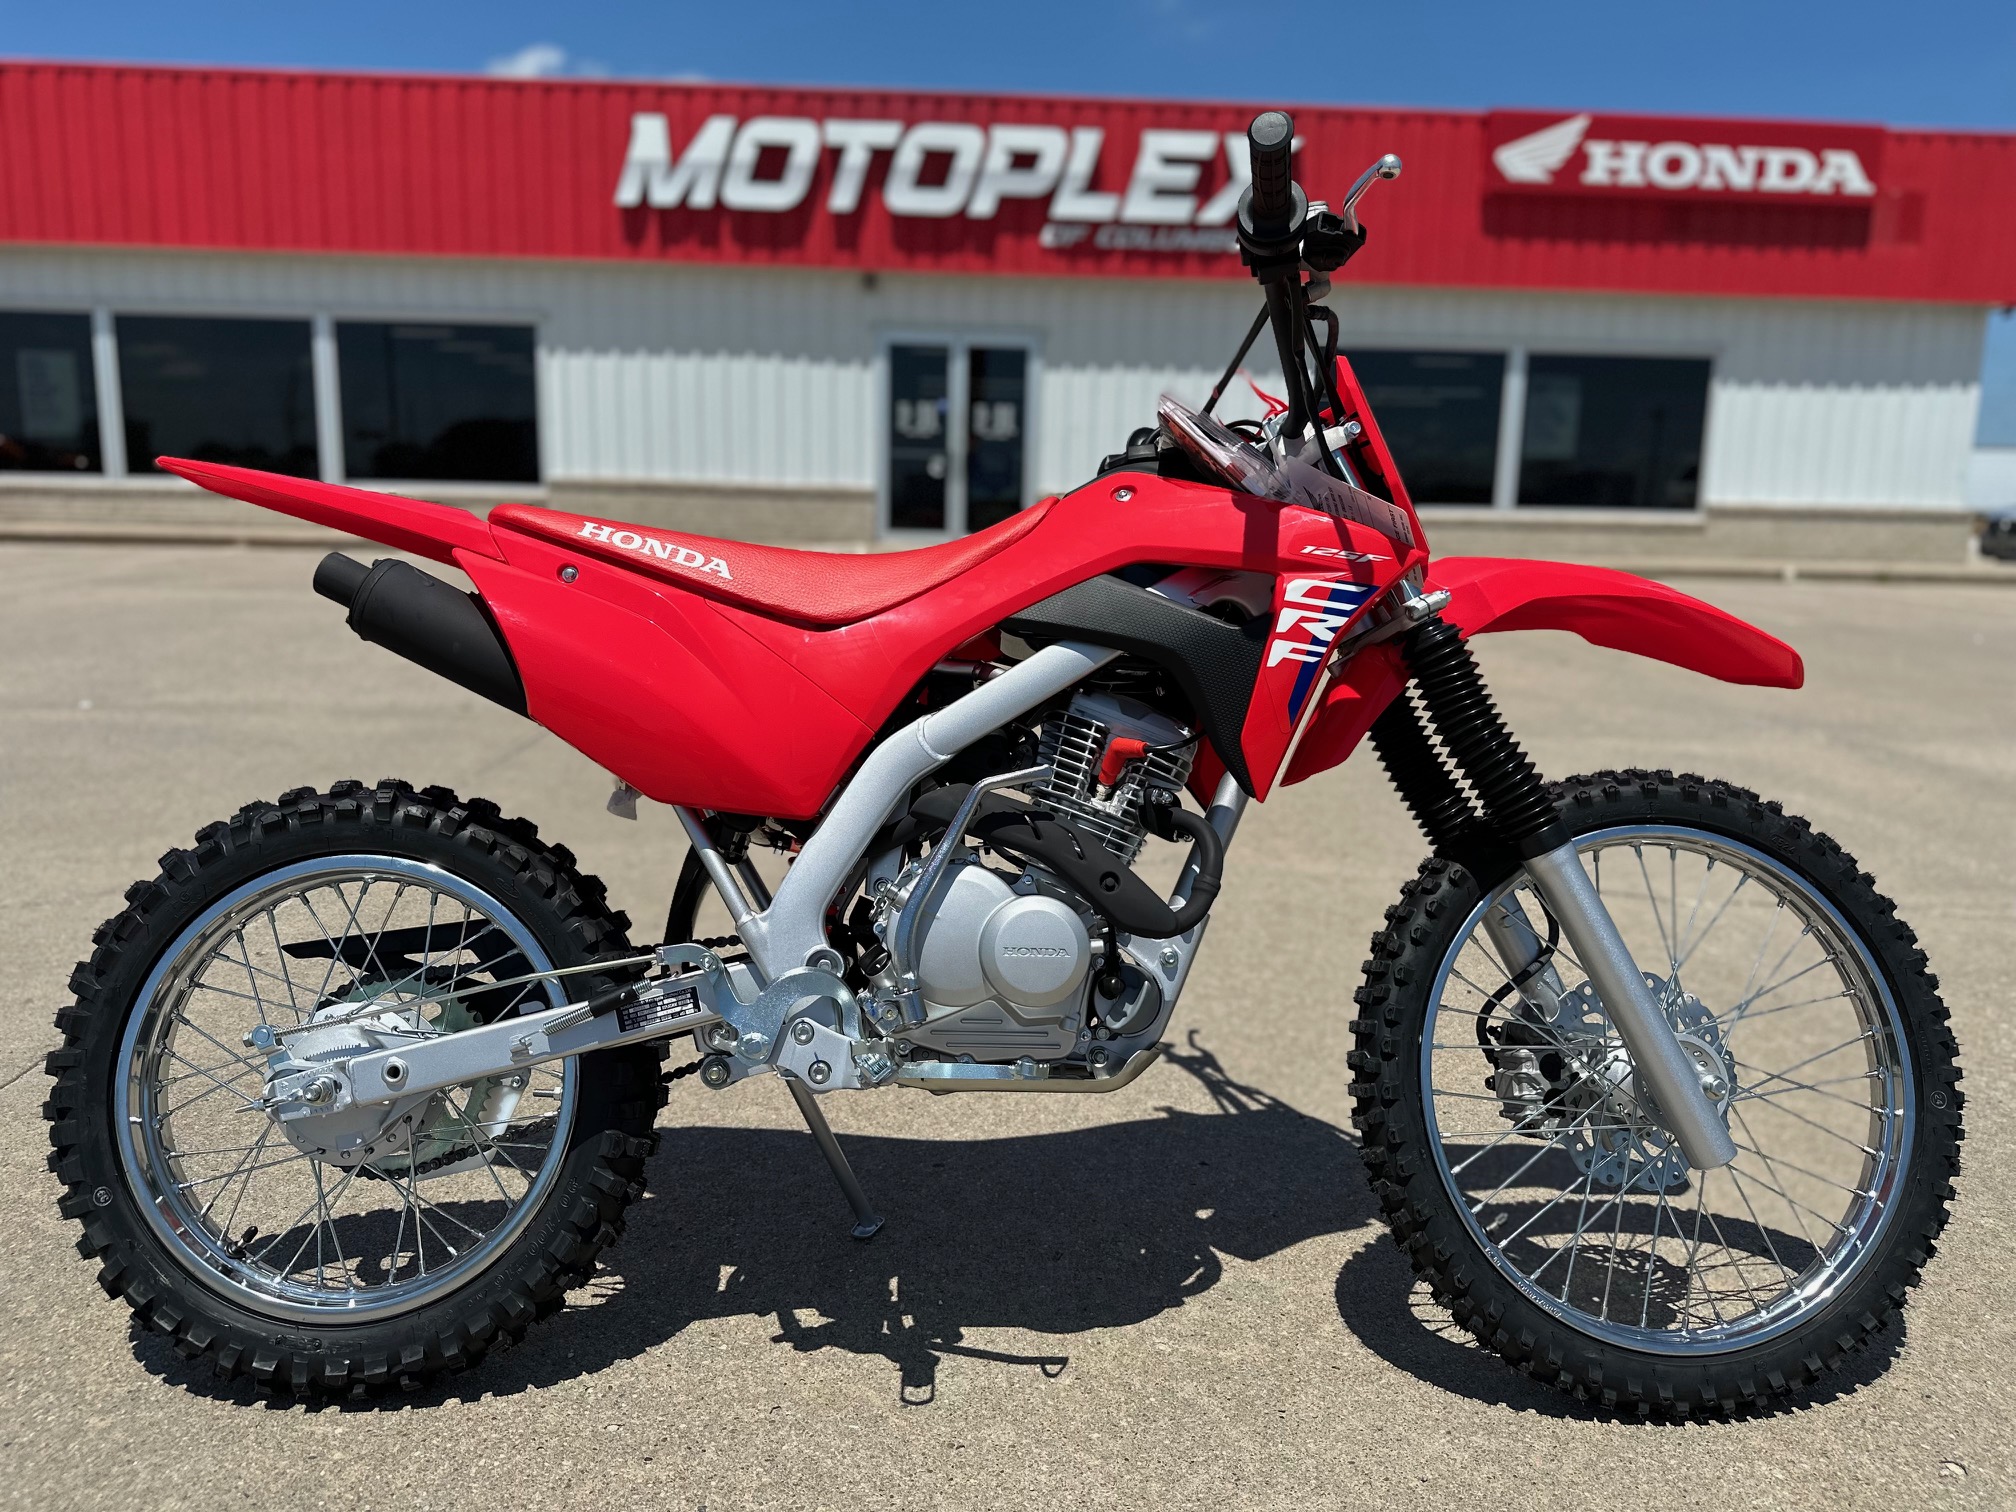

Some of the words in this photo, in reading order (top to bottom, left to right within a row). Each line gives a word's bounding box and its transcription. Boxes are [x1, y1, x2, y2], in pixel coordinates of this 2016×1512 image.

[1580, 139, 1876, 197] HONDA
[577, 521, 734, 580] HONDA
[1300, 545, 1393, 563] 125F
[1266, 578, 1368, 667] CRF
[1002, 946, 1072, 958] HONDA
